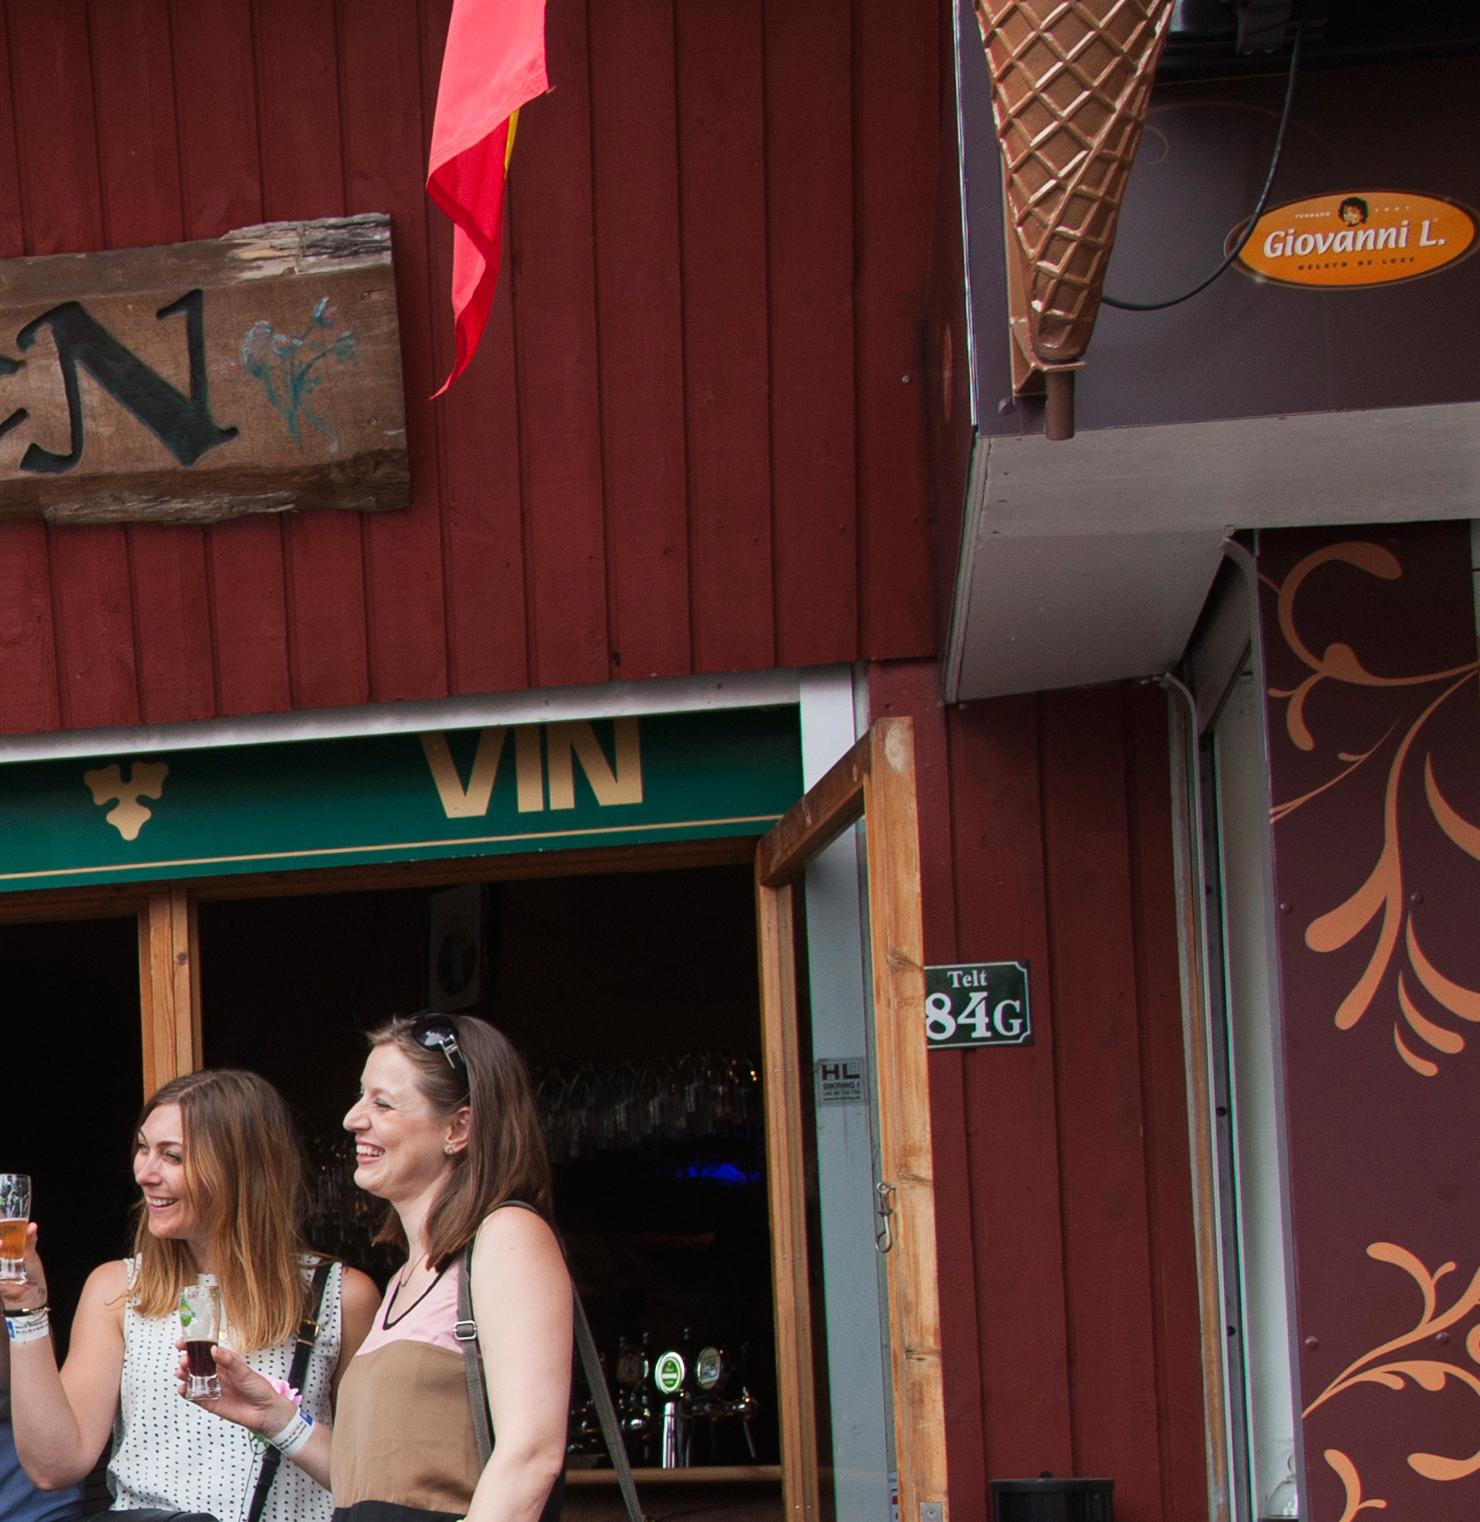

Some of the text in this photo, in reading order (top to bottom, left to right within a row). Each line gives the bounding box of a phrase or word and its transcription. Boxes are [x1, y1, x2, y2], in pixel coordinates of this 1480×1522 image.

[1263, 219, 1446, 258] Giovanni L.
[419, 716, 643, 819] VIN
[947, 968, 988, 989] Telt
[821, 1063, 861, 1080] HL
